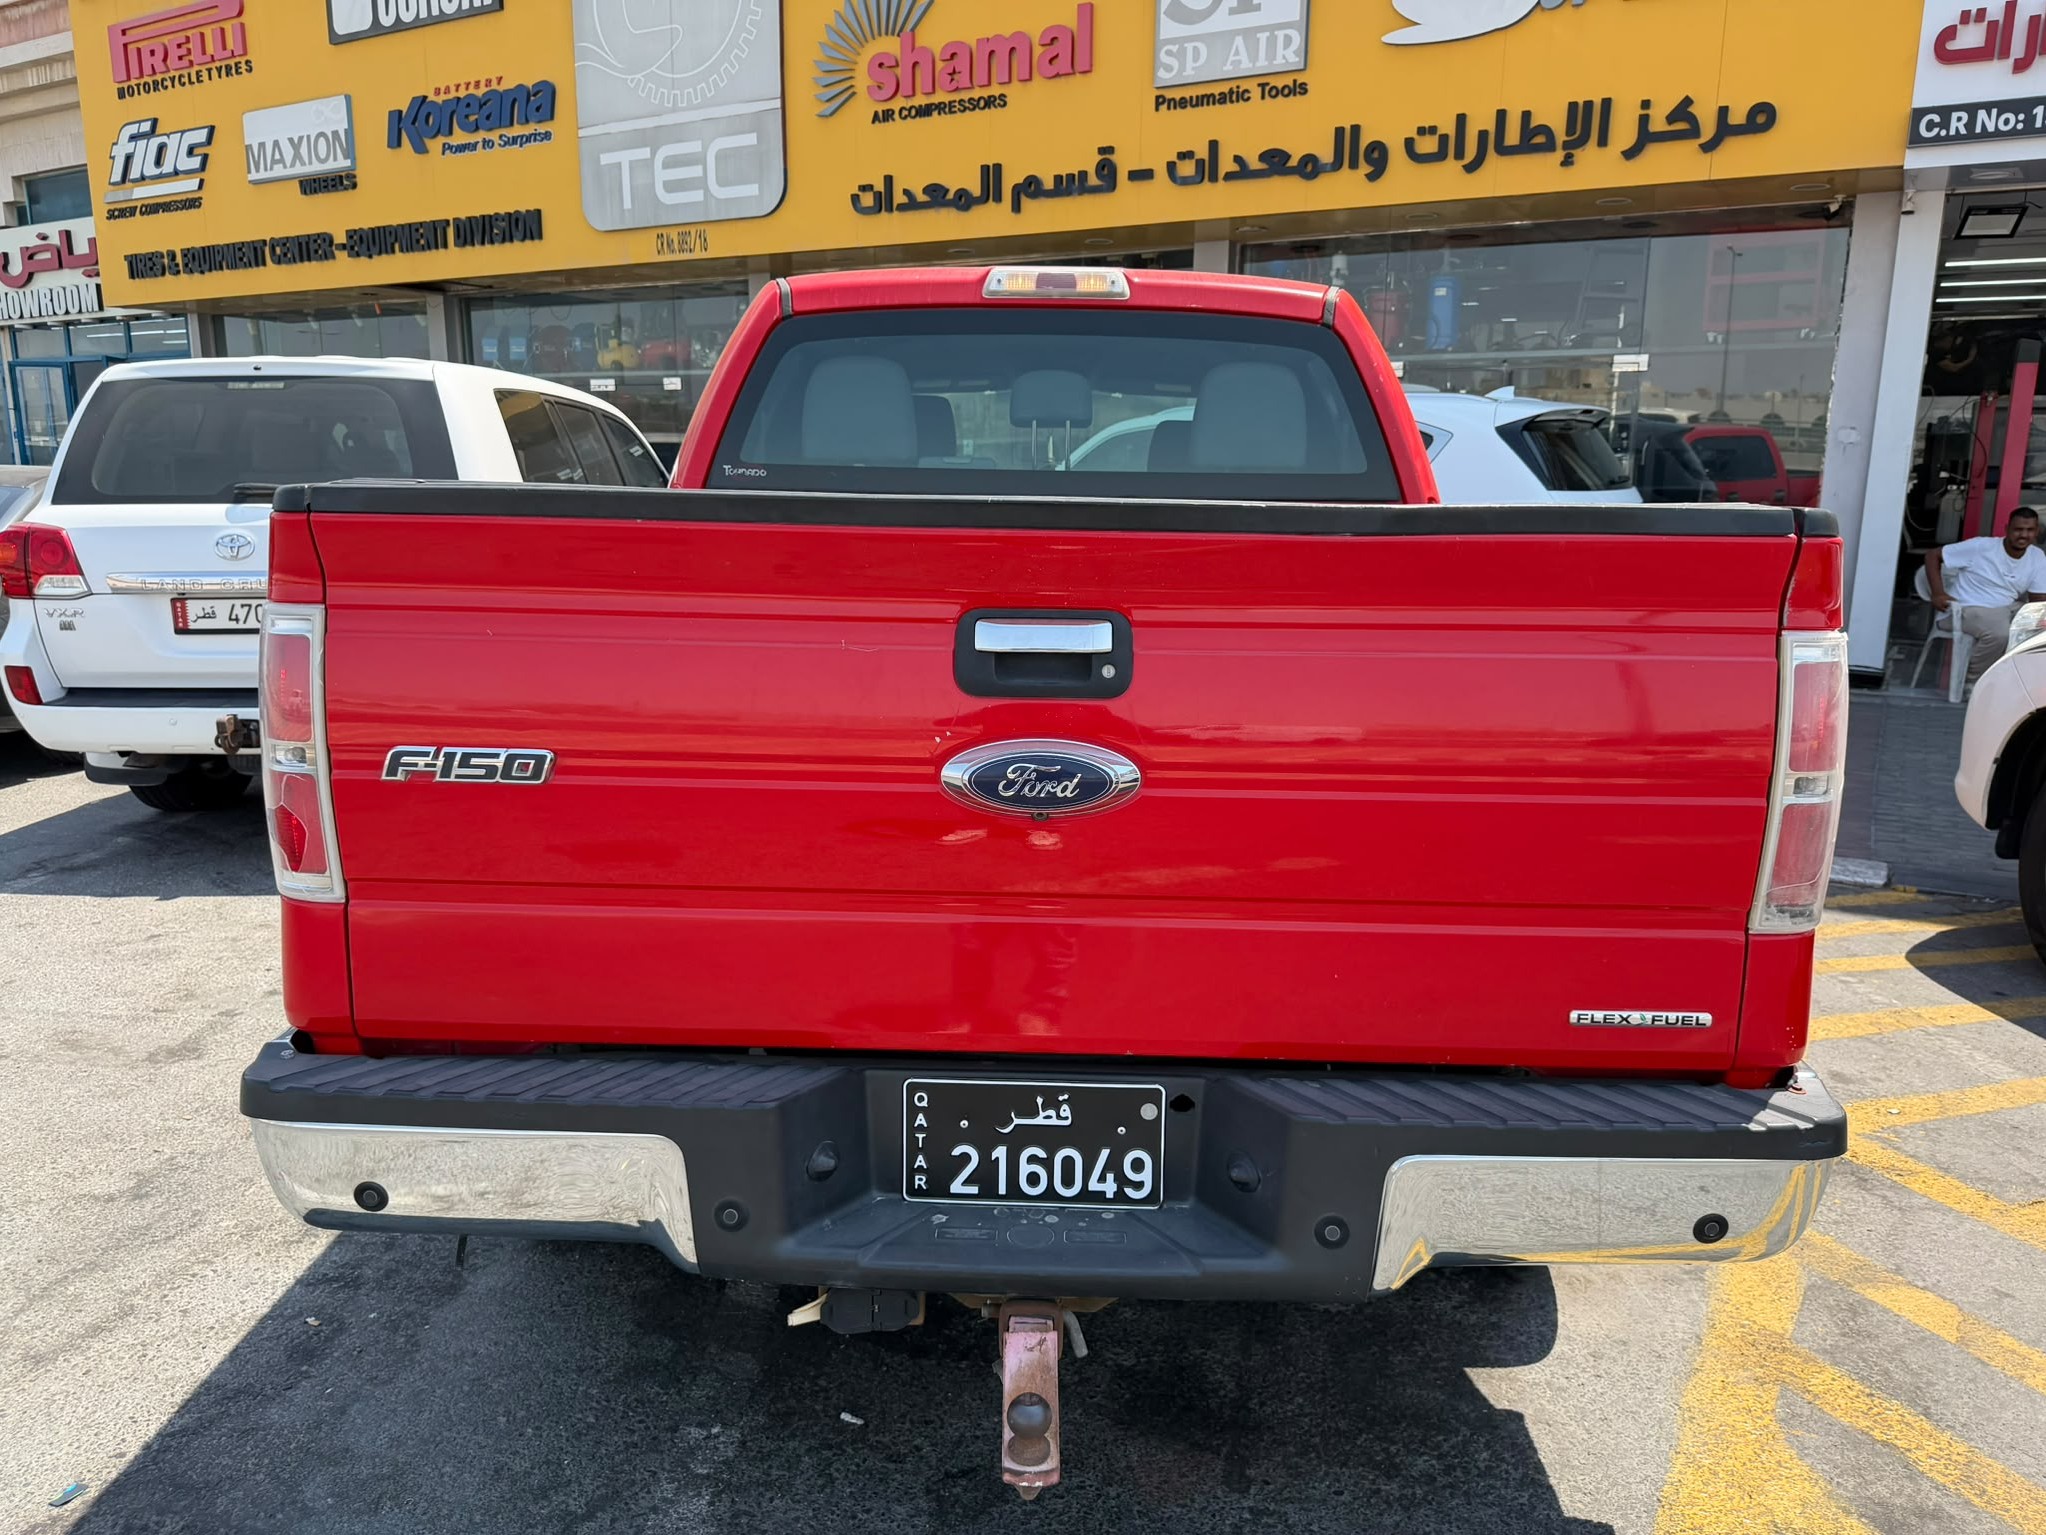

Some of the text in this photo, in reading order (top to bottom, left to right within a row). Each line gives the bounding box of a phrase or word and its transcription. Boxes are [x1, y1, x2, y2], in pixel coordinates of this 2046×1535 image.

[108, 0, 248, 83] PIRELLI
[867, 2, 1093, 102] shamal
[1157, 28, 1301, 79] SP AIR
[433, 76, 503, 96] BATTERY
[871, 93, 1008, 124] AIR COMPRESSORS
[1154, 79, 1308, 112] Pneumatic Tools
[387, 80, 556, 155] Koreana
[1404, 97, 1613, 174] الإطارات
[1621, 95, 1778, 161] مركز
[1919, 111, 1969, 138] C.R
[1975, 108, 2025, 134] No:
[109, 117, 215, 186] fiac
[245, 128, 351, 174] MAXION
[441, 128, 552, 156] Power to Surprise
[1166, 124, 1389, 186] والمعدات
[298, 172, 358, 196] WHEELS
[600, 132, 759, 210] TEC
[850, 163, 1003, 215] المعدات
[1011, 145, 1117, 214] قسم
[106, 196, 203, 221] SCREW COMPRESSORS
[124, 251, 166, 280] TIRES
[165, 249, 181, 276] &
[180, 239, 267, 275] EQUIPMENT
[452, 208, 543, 248] DIVISION
[141, 578, 204, 591] LAND
[190, 606, 217, 623] قطر
[381, 745, 557, 784] F-150
[998, 763, 1082, 798] Ford
[1576, 1013, 1707, 1026] FLEX FUEL
[995, 1093, 1073, 1134] قطر
[913, 1092, 929, 1190] QATAR
[949, 1144, 1154, 1200] 216049
